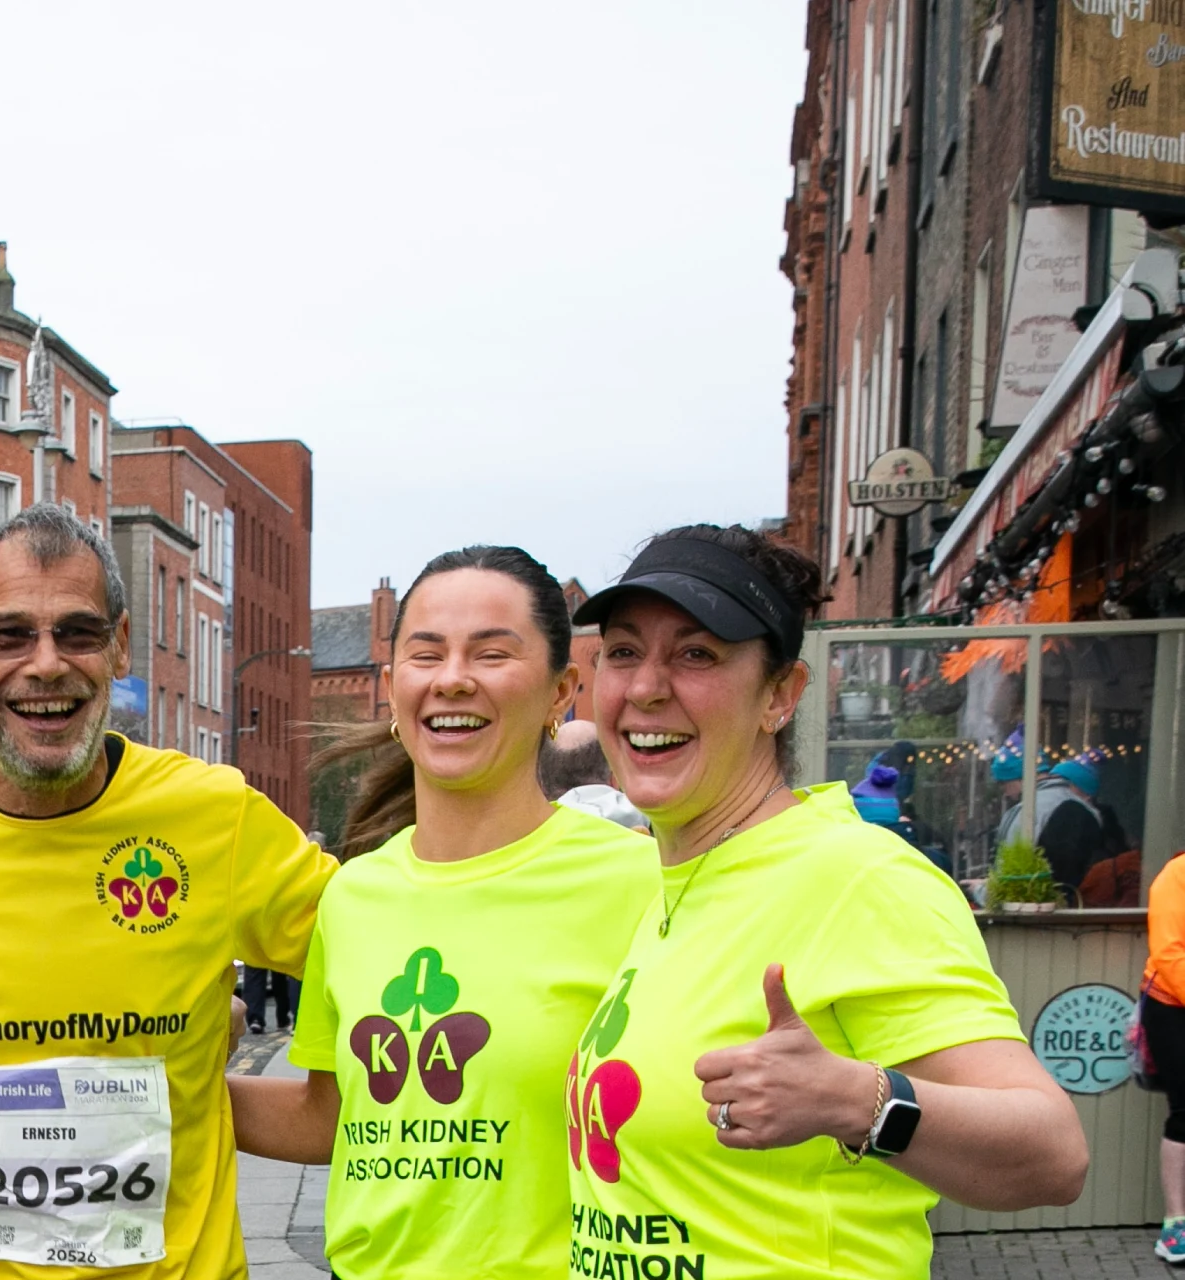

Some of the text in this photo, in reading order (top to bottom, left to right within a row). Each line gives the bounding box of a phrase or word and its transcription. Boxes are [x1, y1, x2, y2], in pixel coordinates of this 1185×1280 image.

[1107, 76, 1150, 110] And
[857, 480, 945, 500] HOLSTEN
[95, 836, 190, 906] IRISH KIDNEY ASSOCIATION
[111, 912, 180, 934] BE A DONOR
[1087, 995, 1132, 1020] WHISKE
[0, 1083, 52, 1097] Irish Life
[74, 1079, 148, 1094] DUBLIN
[22, 1127, 77, 1140] ERNESTO
[344, 1119, 510, 1146] IRISH KIDNEY
[345, 1157, 503, 1182] ASSOCIATION
[588, 1206, 690, 1244] KIDNEY
[47, 1249, 97, 1264] 20526
